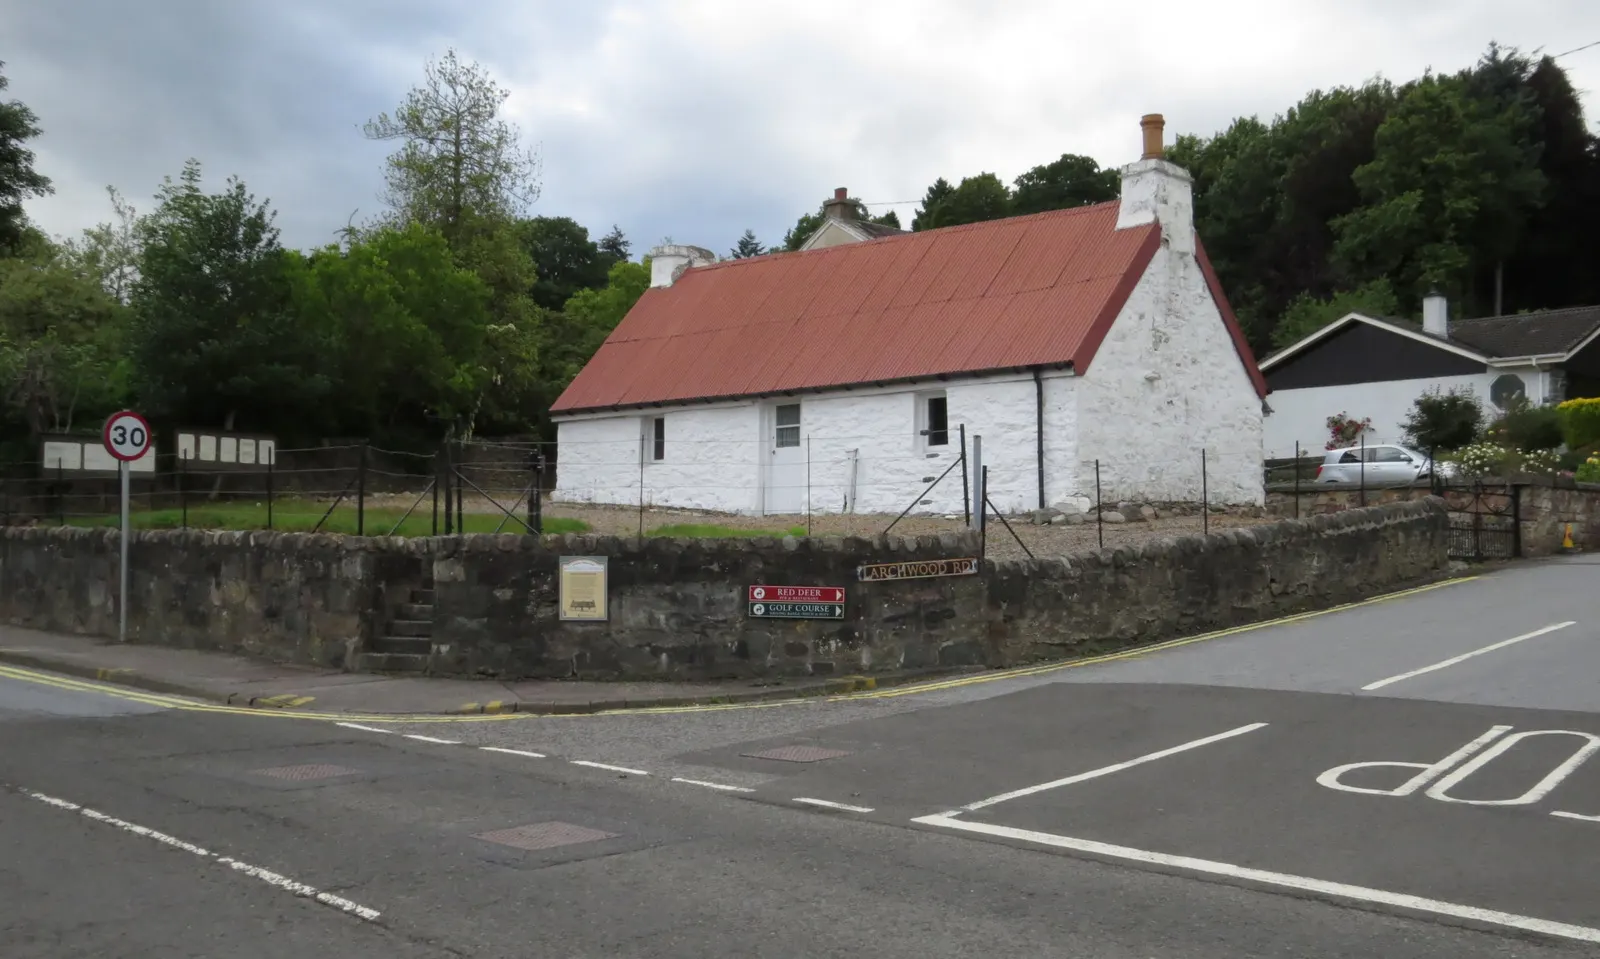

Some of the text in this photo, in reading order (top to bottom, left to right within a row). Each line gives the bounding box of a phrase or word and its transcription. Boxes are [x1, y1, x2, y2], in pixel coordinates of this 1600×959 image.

[113, 425, 145, 447] 30
[952, 561, 971, 575] RD
[778, 588, 794, 596] RED
